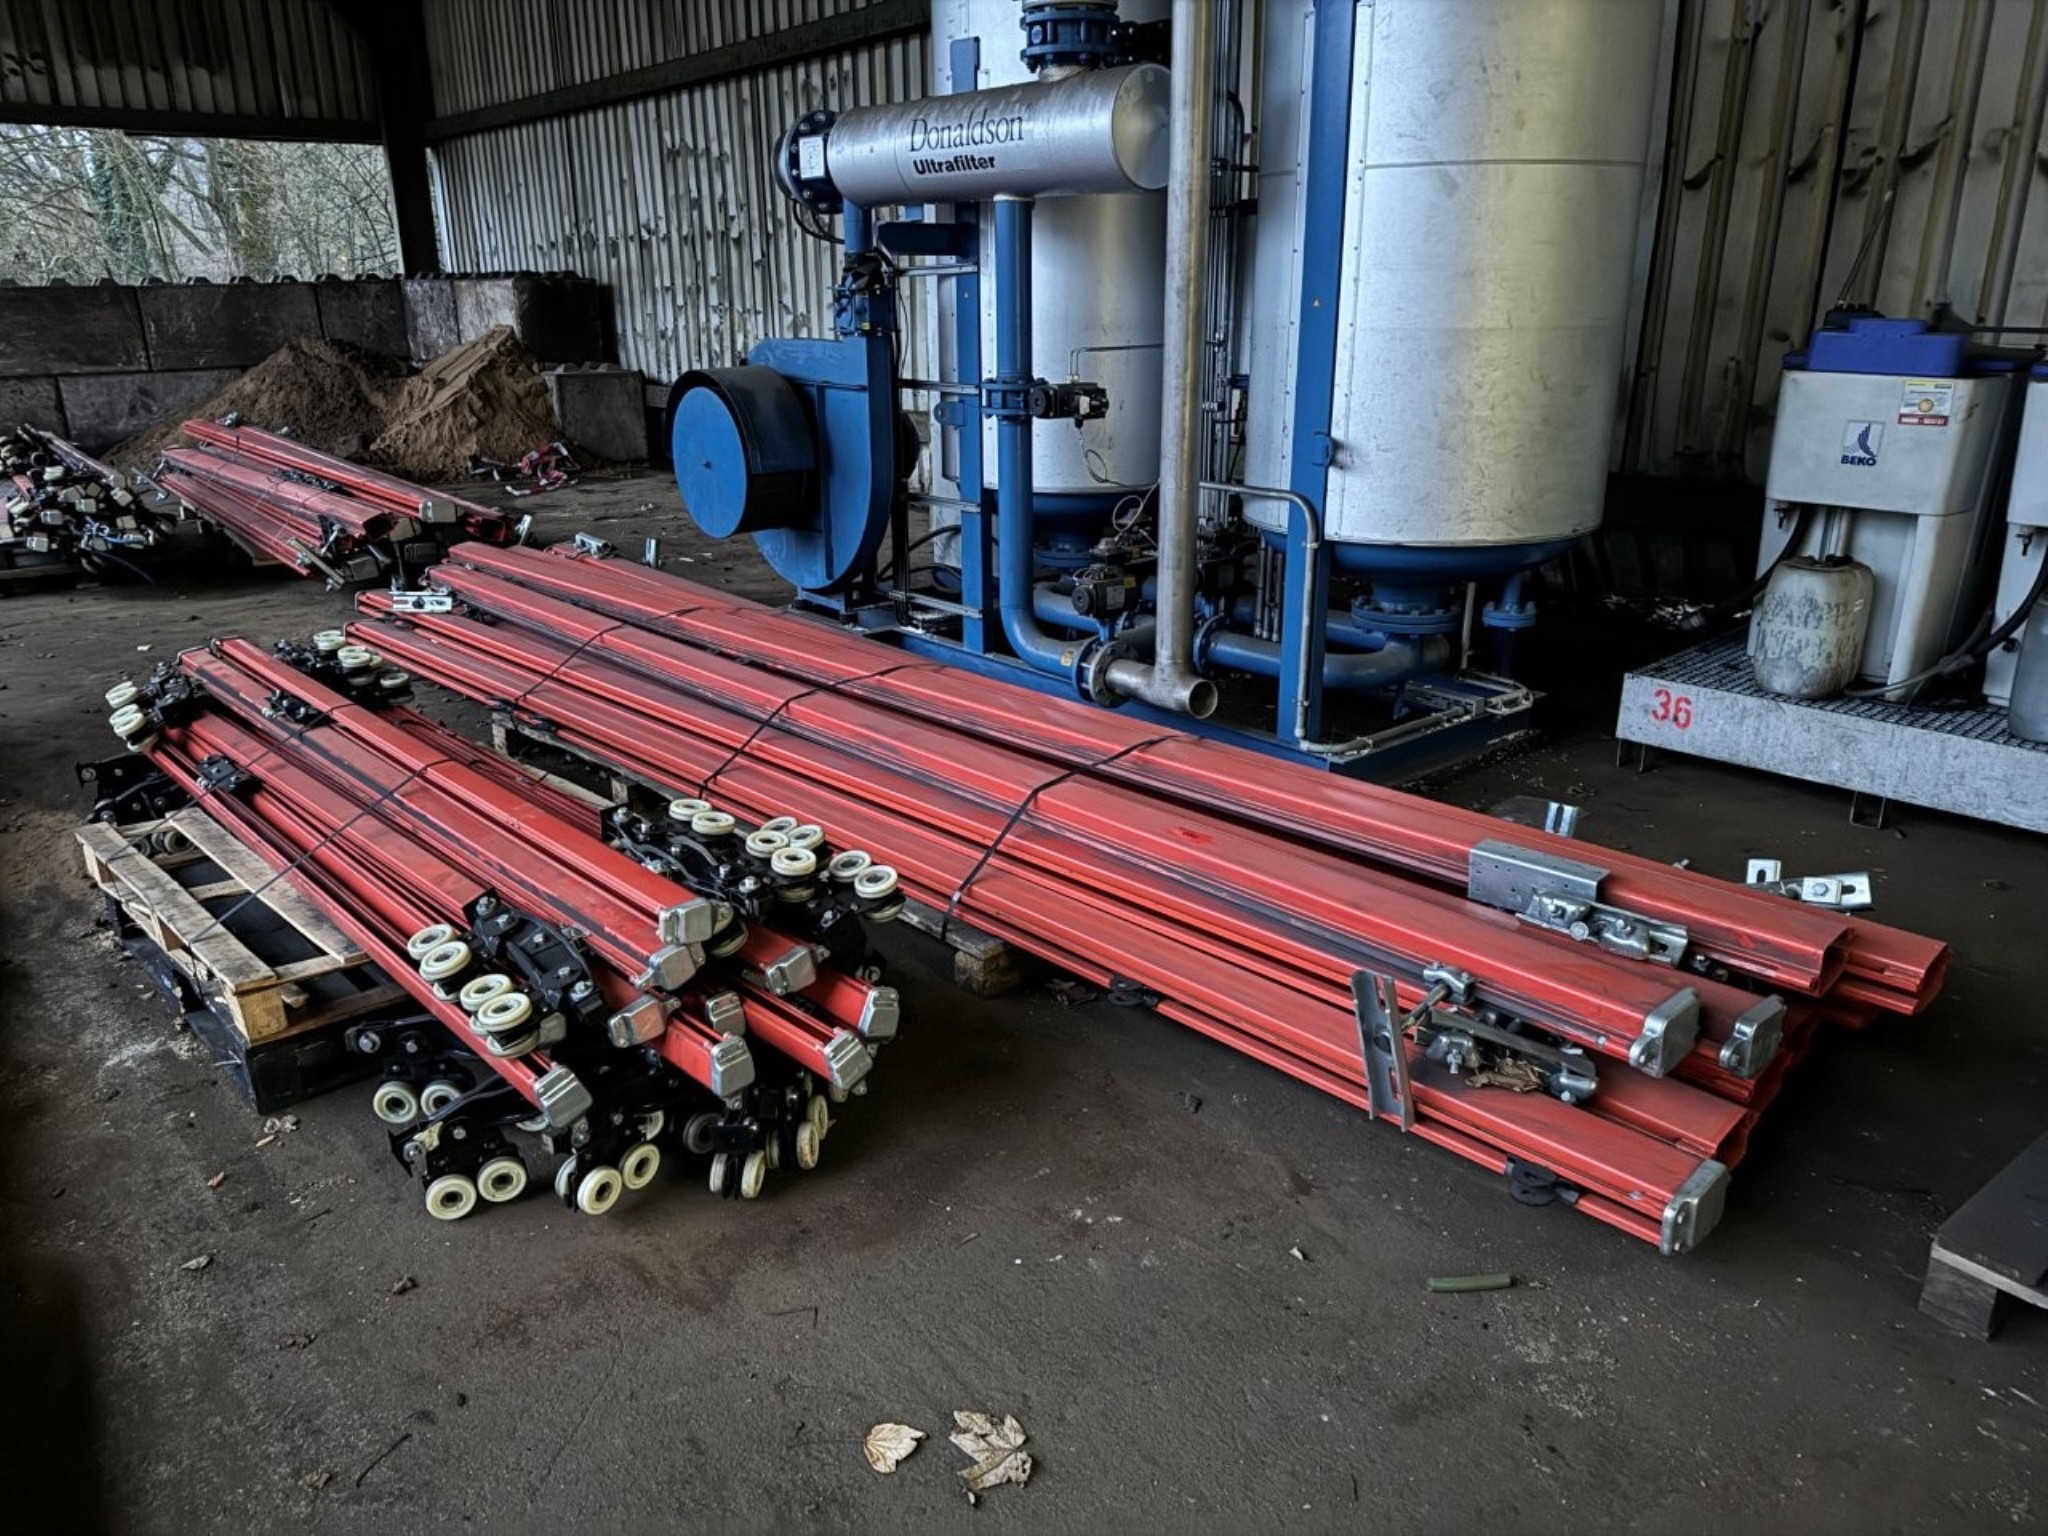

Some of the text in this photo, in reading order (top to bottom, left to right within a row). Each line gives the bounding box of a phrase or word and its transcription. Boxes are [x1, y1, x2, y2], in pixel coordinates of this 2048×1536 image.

[909, 108, 1024, 152] Donaldson
[912, 154, 996, 175] Ultrafilter
[1841, 454, 1877, 467] BEKO
[1651, 688, 1692, 730] 36
